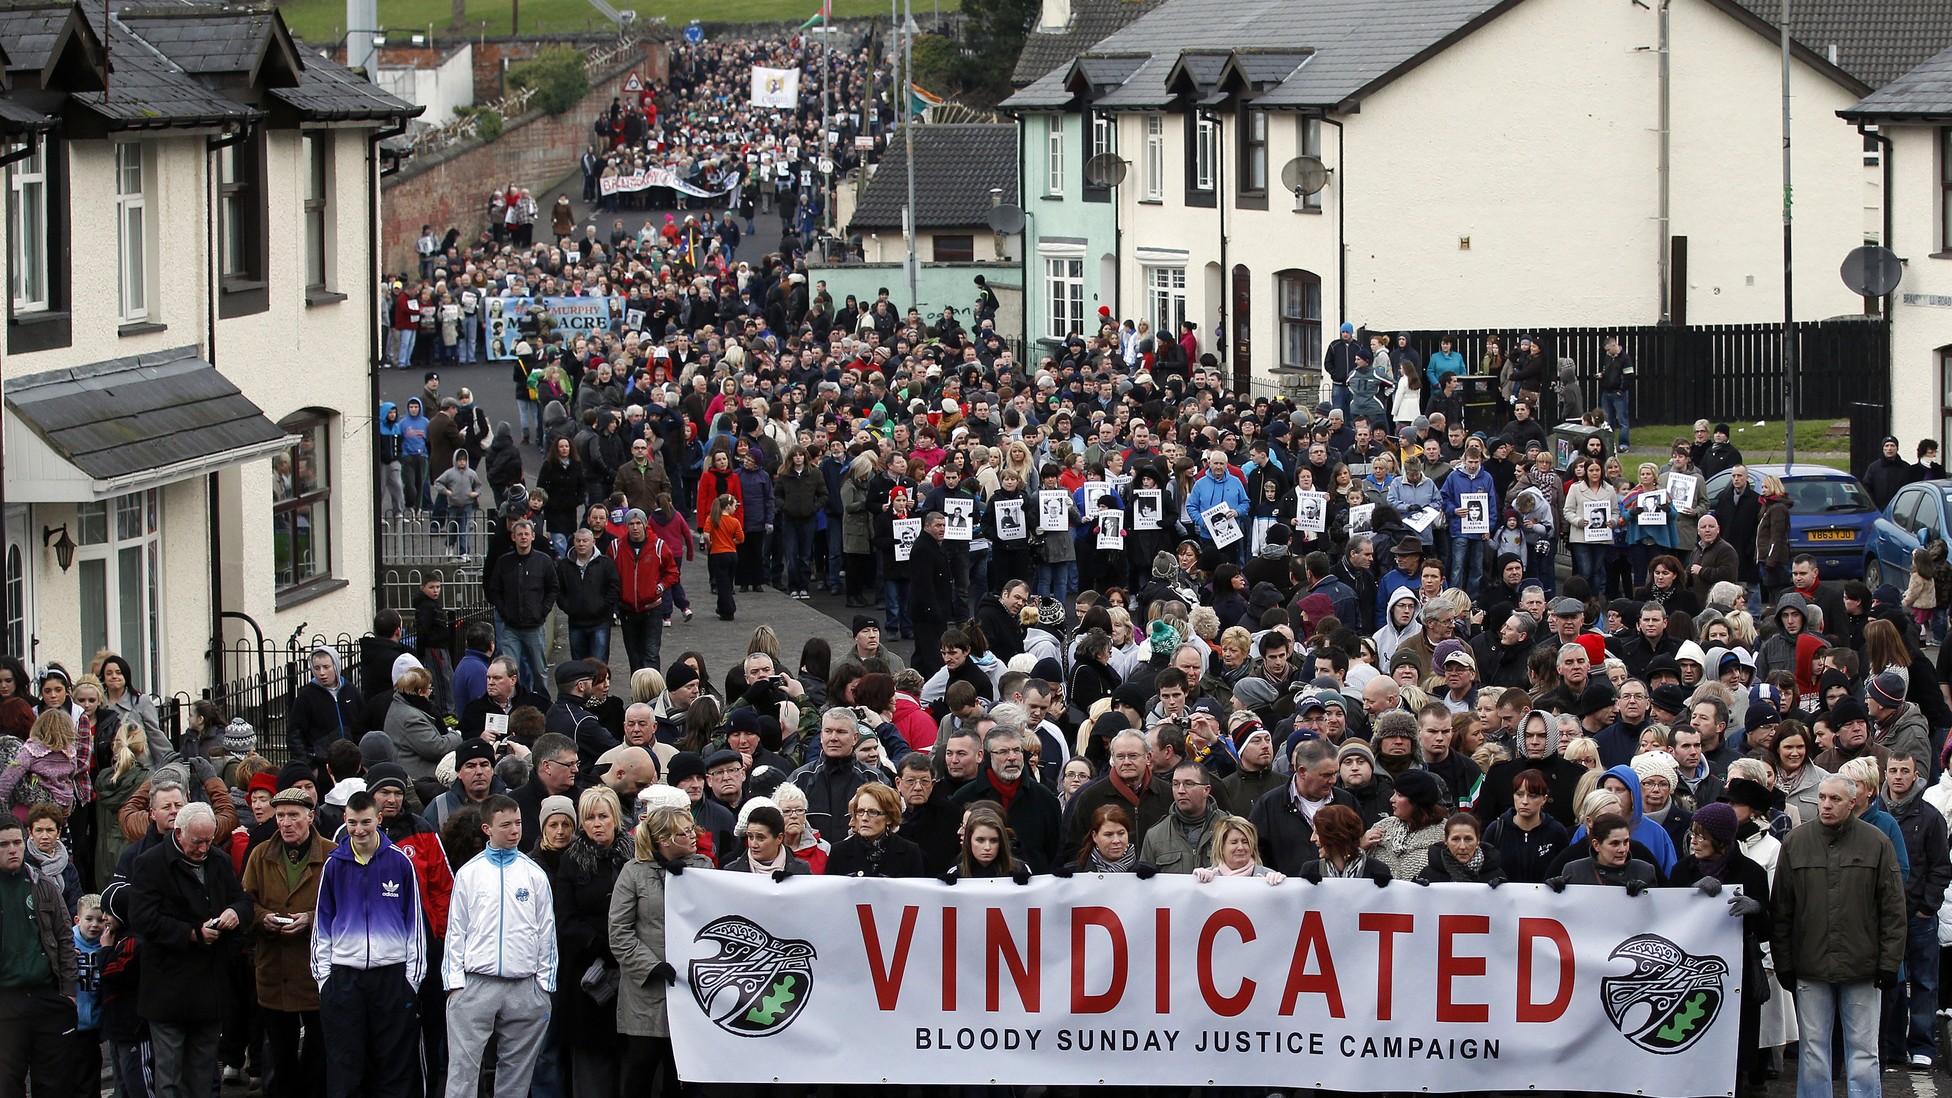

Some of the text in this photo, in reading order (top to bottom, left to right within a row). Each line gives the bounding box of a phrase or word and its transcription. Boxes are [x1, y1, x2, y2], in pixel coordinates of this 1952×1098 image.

[507, 317, 608, 329] MACRE
[1203, 504, 1227, 518] VINDICATED
[858, 905, 1575, 1024] VINDICATED
[917, 1028, 1501, 1059] BLOODY SUNDAY JUSTICE CAMPAIGN
